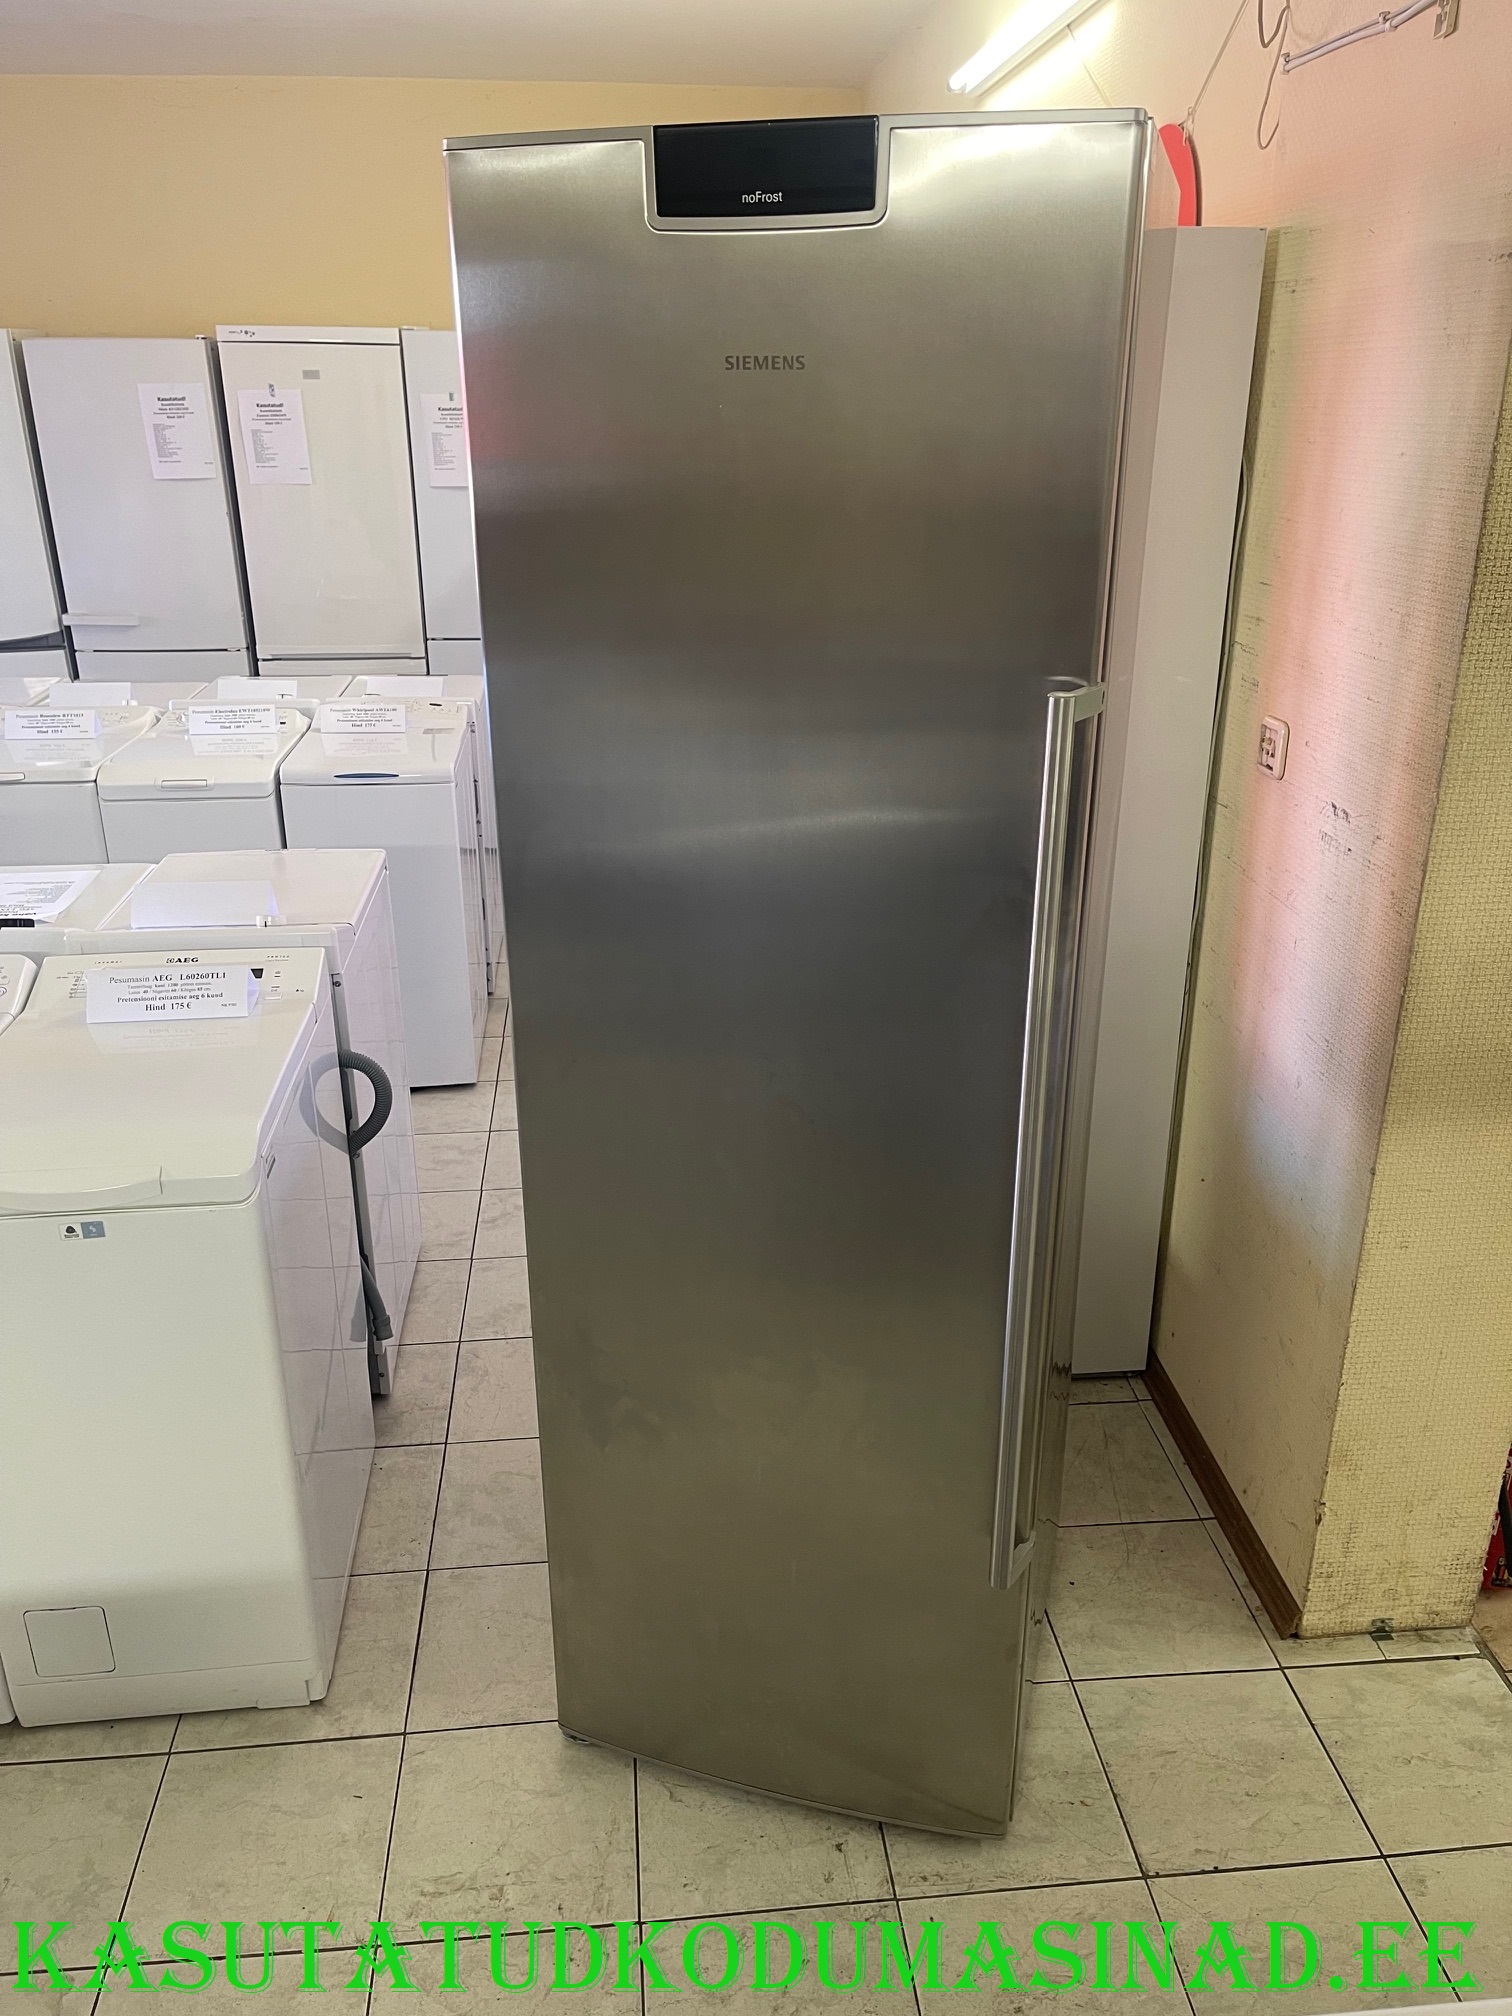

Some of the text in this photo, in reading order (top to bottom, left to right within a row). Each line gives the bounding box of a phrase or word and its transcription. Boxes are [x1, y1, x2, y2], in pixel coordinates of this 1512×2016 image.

[741, 191, 783, 204] noFrost
[724, 355, 806, 371] SIEMENS
[109, 972, 226, 984] Pesumasin AEG L60260TL1
[145, 1002, 192, 1011] Hind 175 €
